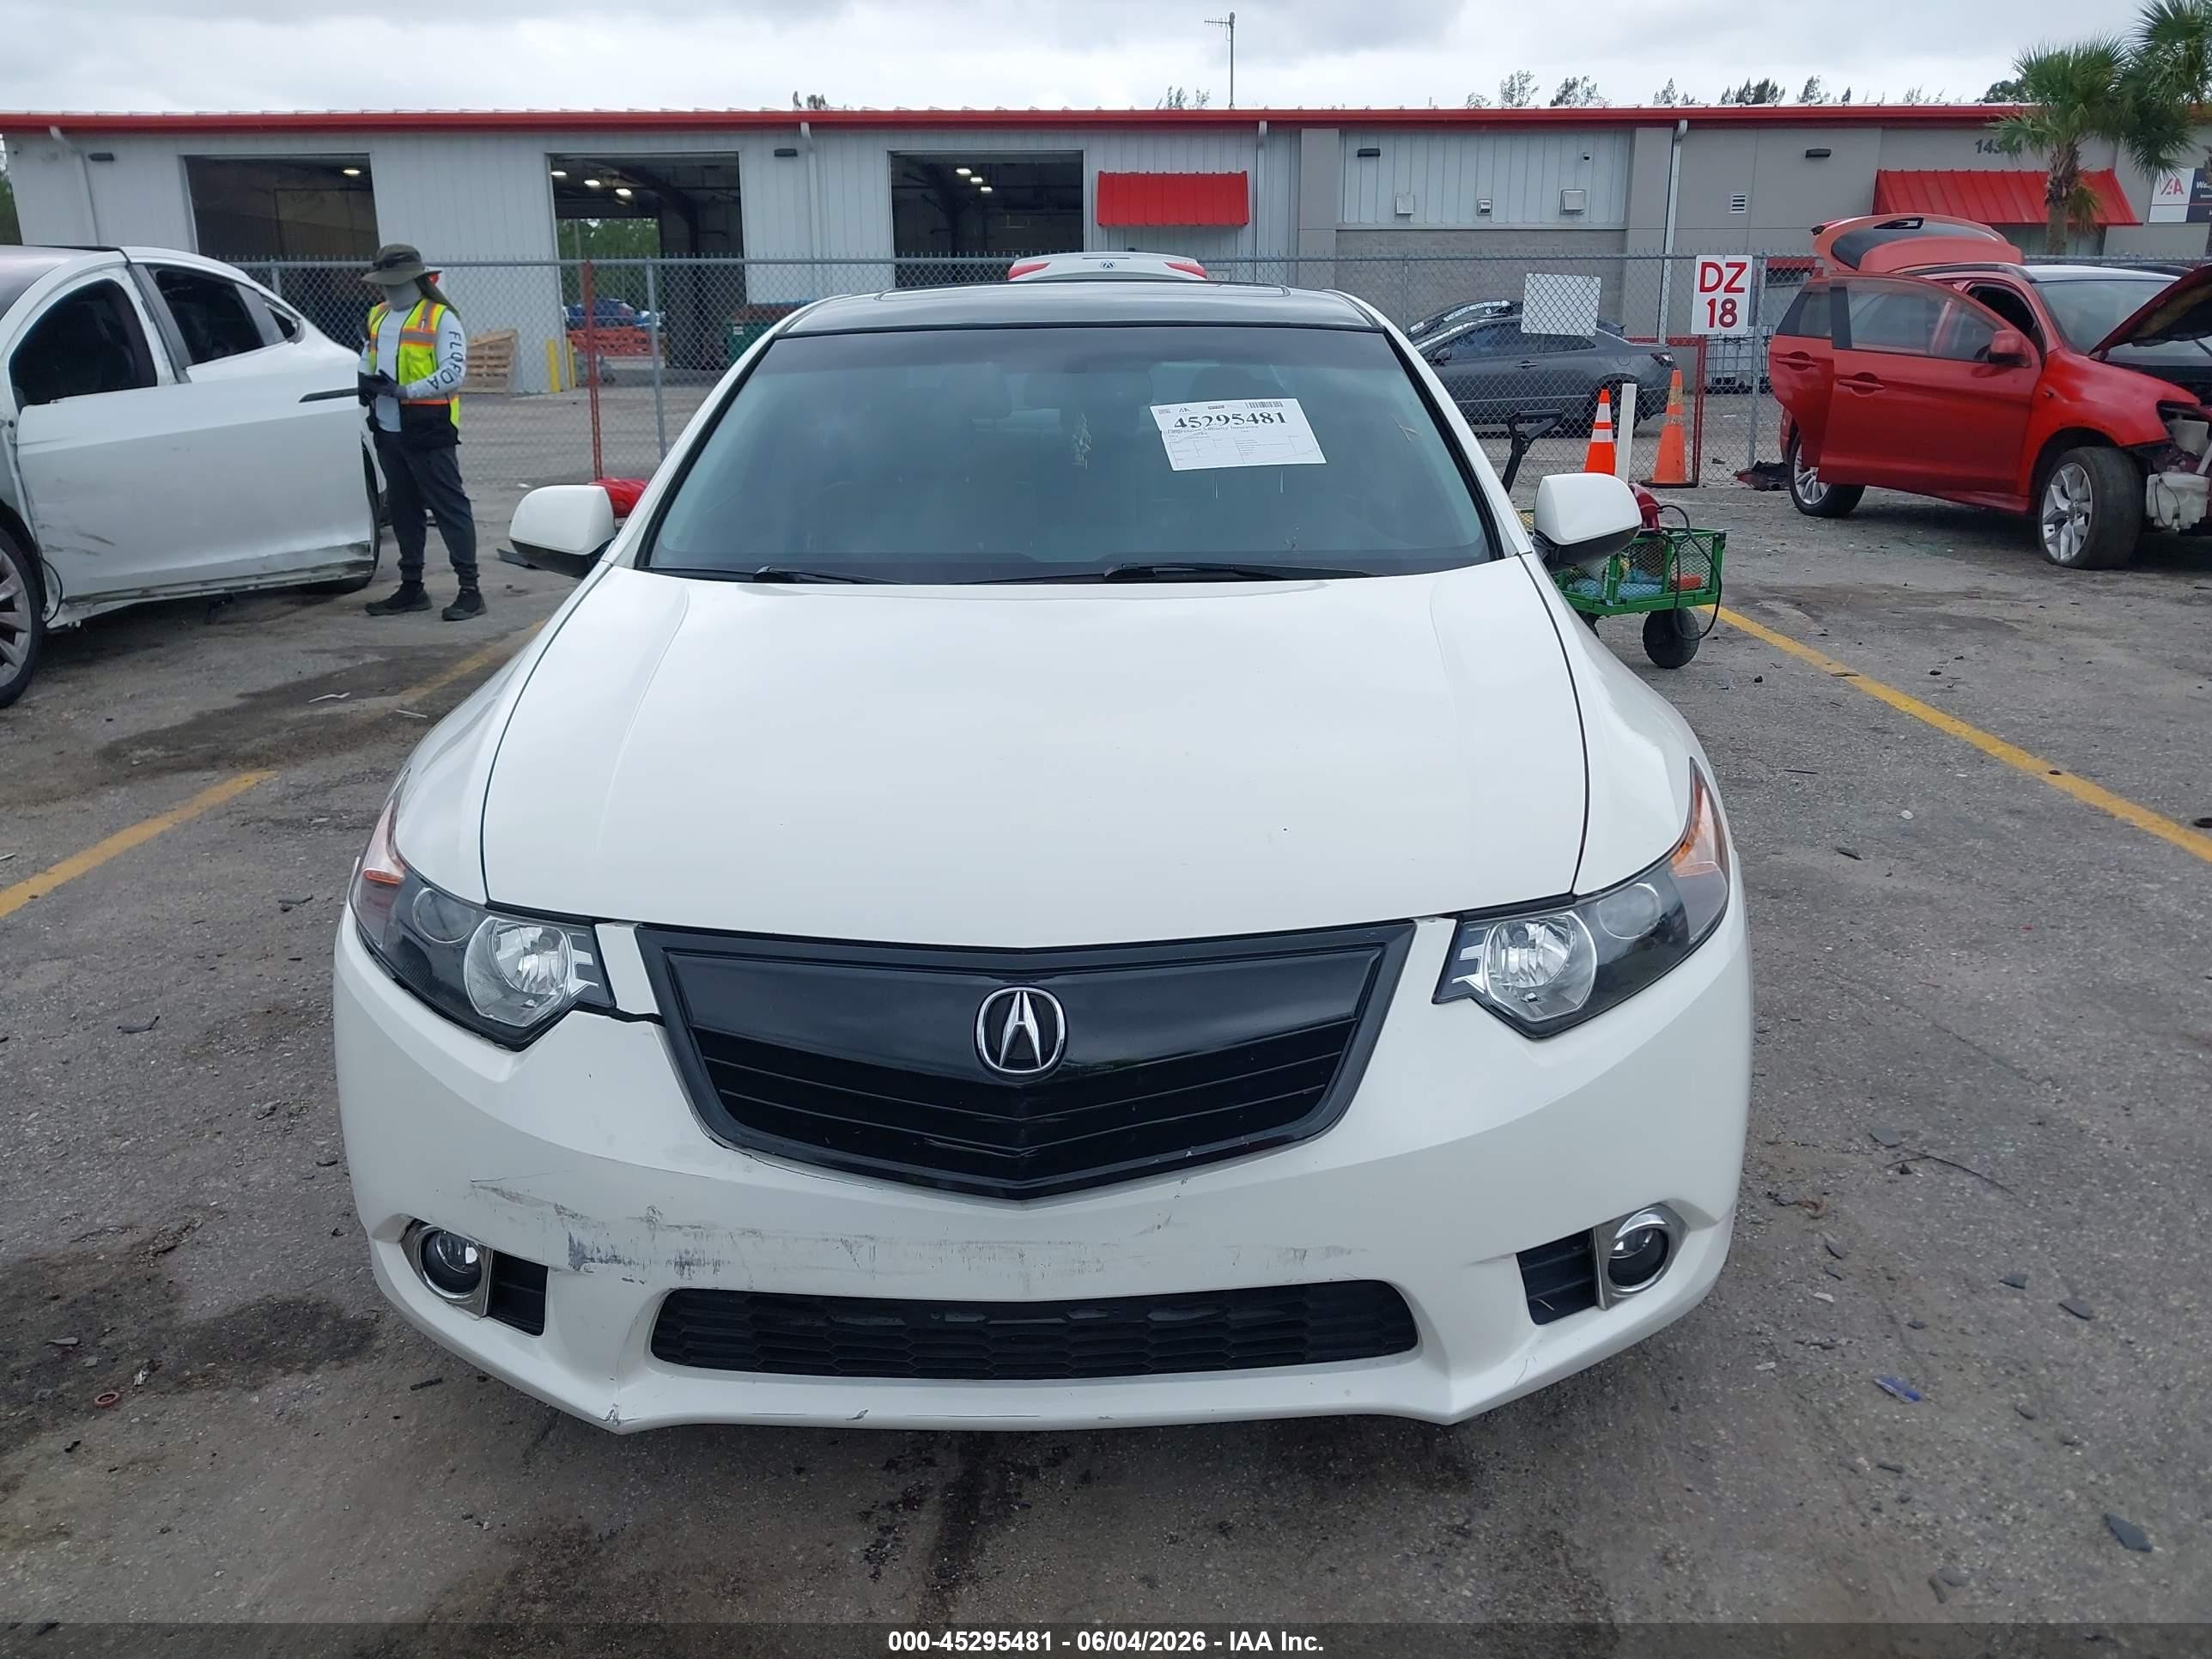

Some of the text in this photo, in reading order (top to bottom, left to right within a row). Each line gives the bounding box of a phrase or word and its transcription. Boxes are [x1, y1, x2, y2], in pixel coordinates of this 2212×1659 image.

[1698, 261, 1747, 294] DZ
[1706, 297, 1738, 329] 18
[427, 331, 464, 391] FLORDA
[1174, 411, 1287, 428] 45295481
